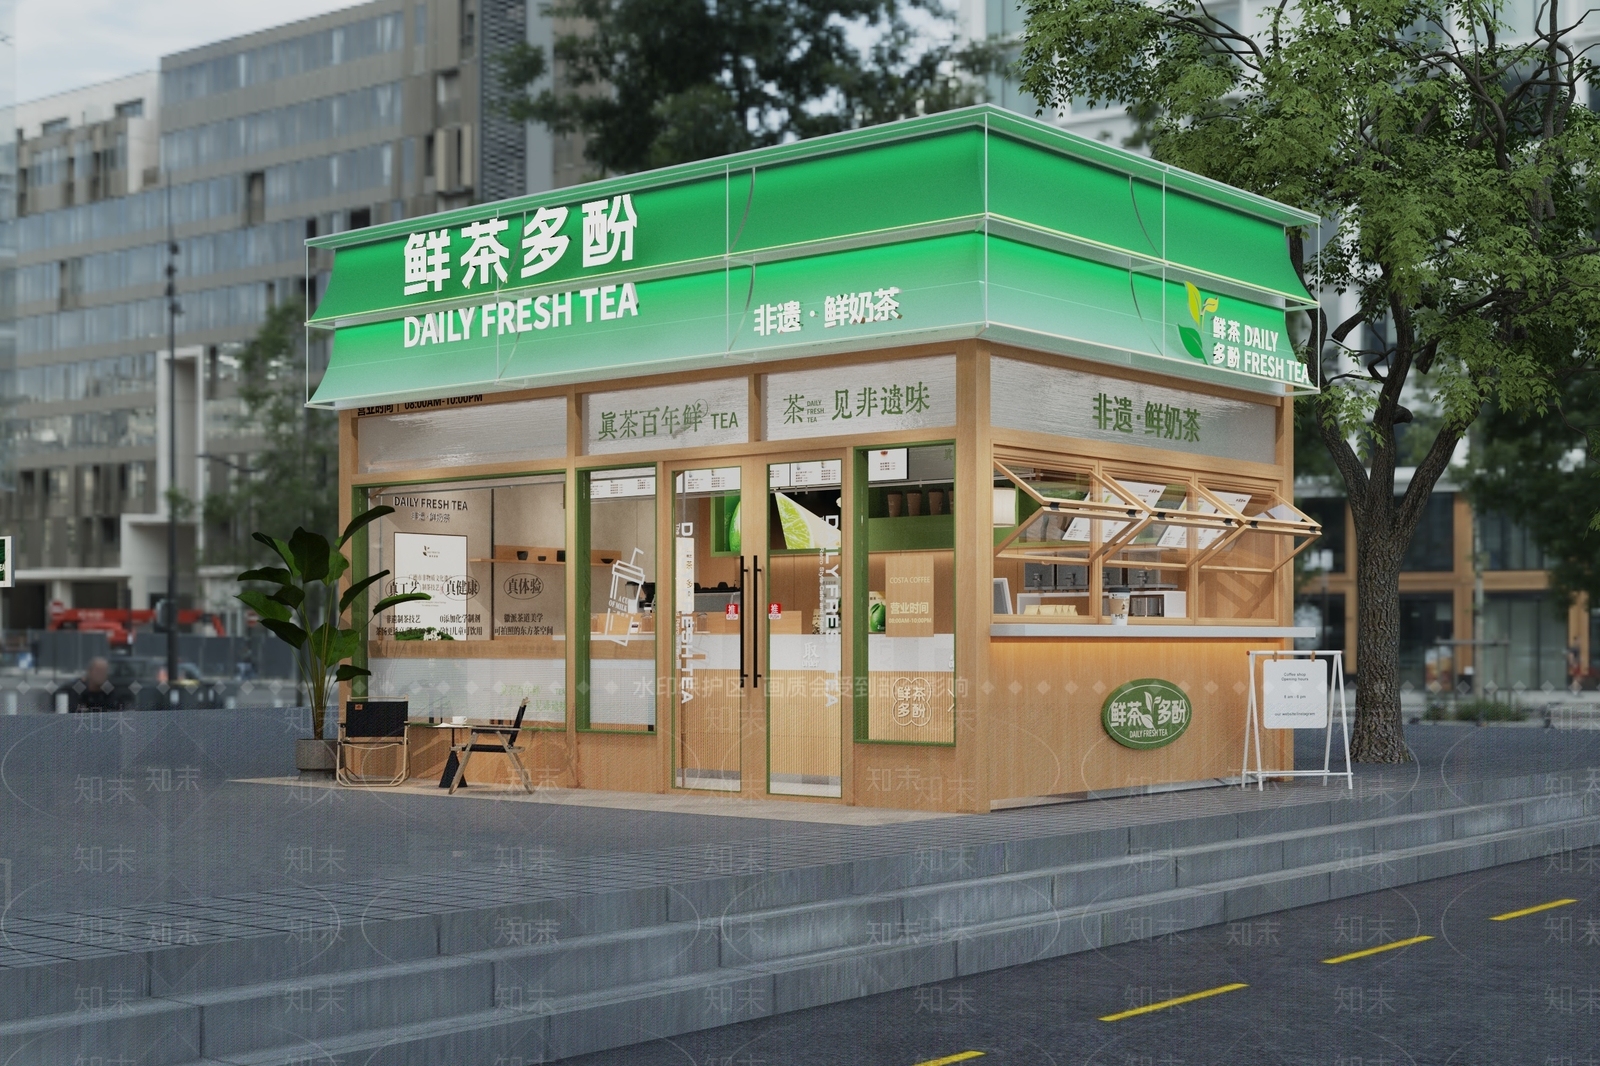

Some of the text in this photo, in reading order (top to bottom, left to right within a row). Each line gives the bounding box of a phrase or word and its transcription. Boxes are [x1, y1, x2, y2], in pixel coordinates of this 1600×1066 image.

[404, 194, 638, 296] 鲜茶多酚
[404, 283, 639, 348] DAILY FRESH TEA
[1213, 316, 1278, 352] 鲜茶 DAILY
[1244, 351, 1284, 379] FRESH
[1287, 360, 1309, 384] TEA
[783, 381, 930, 425] 茶 见非遗味
[806, 407, 824, 415] FRESH
[710, 412, 739, 430] TEA
[394, 496, 468, 511] DAILY FRESH TEA
[507, 577, 543, 596] 真体验
[890, 602, 929, 614] 营业时间
[898, 686, 926, 701] 鲜茶
[1110, 699, 1186, 727] 鲜茶 多酚
[1159, 728, 1168, 736] TEA
